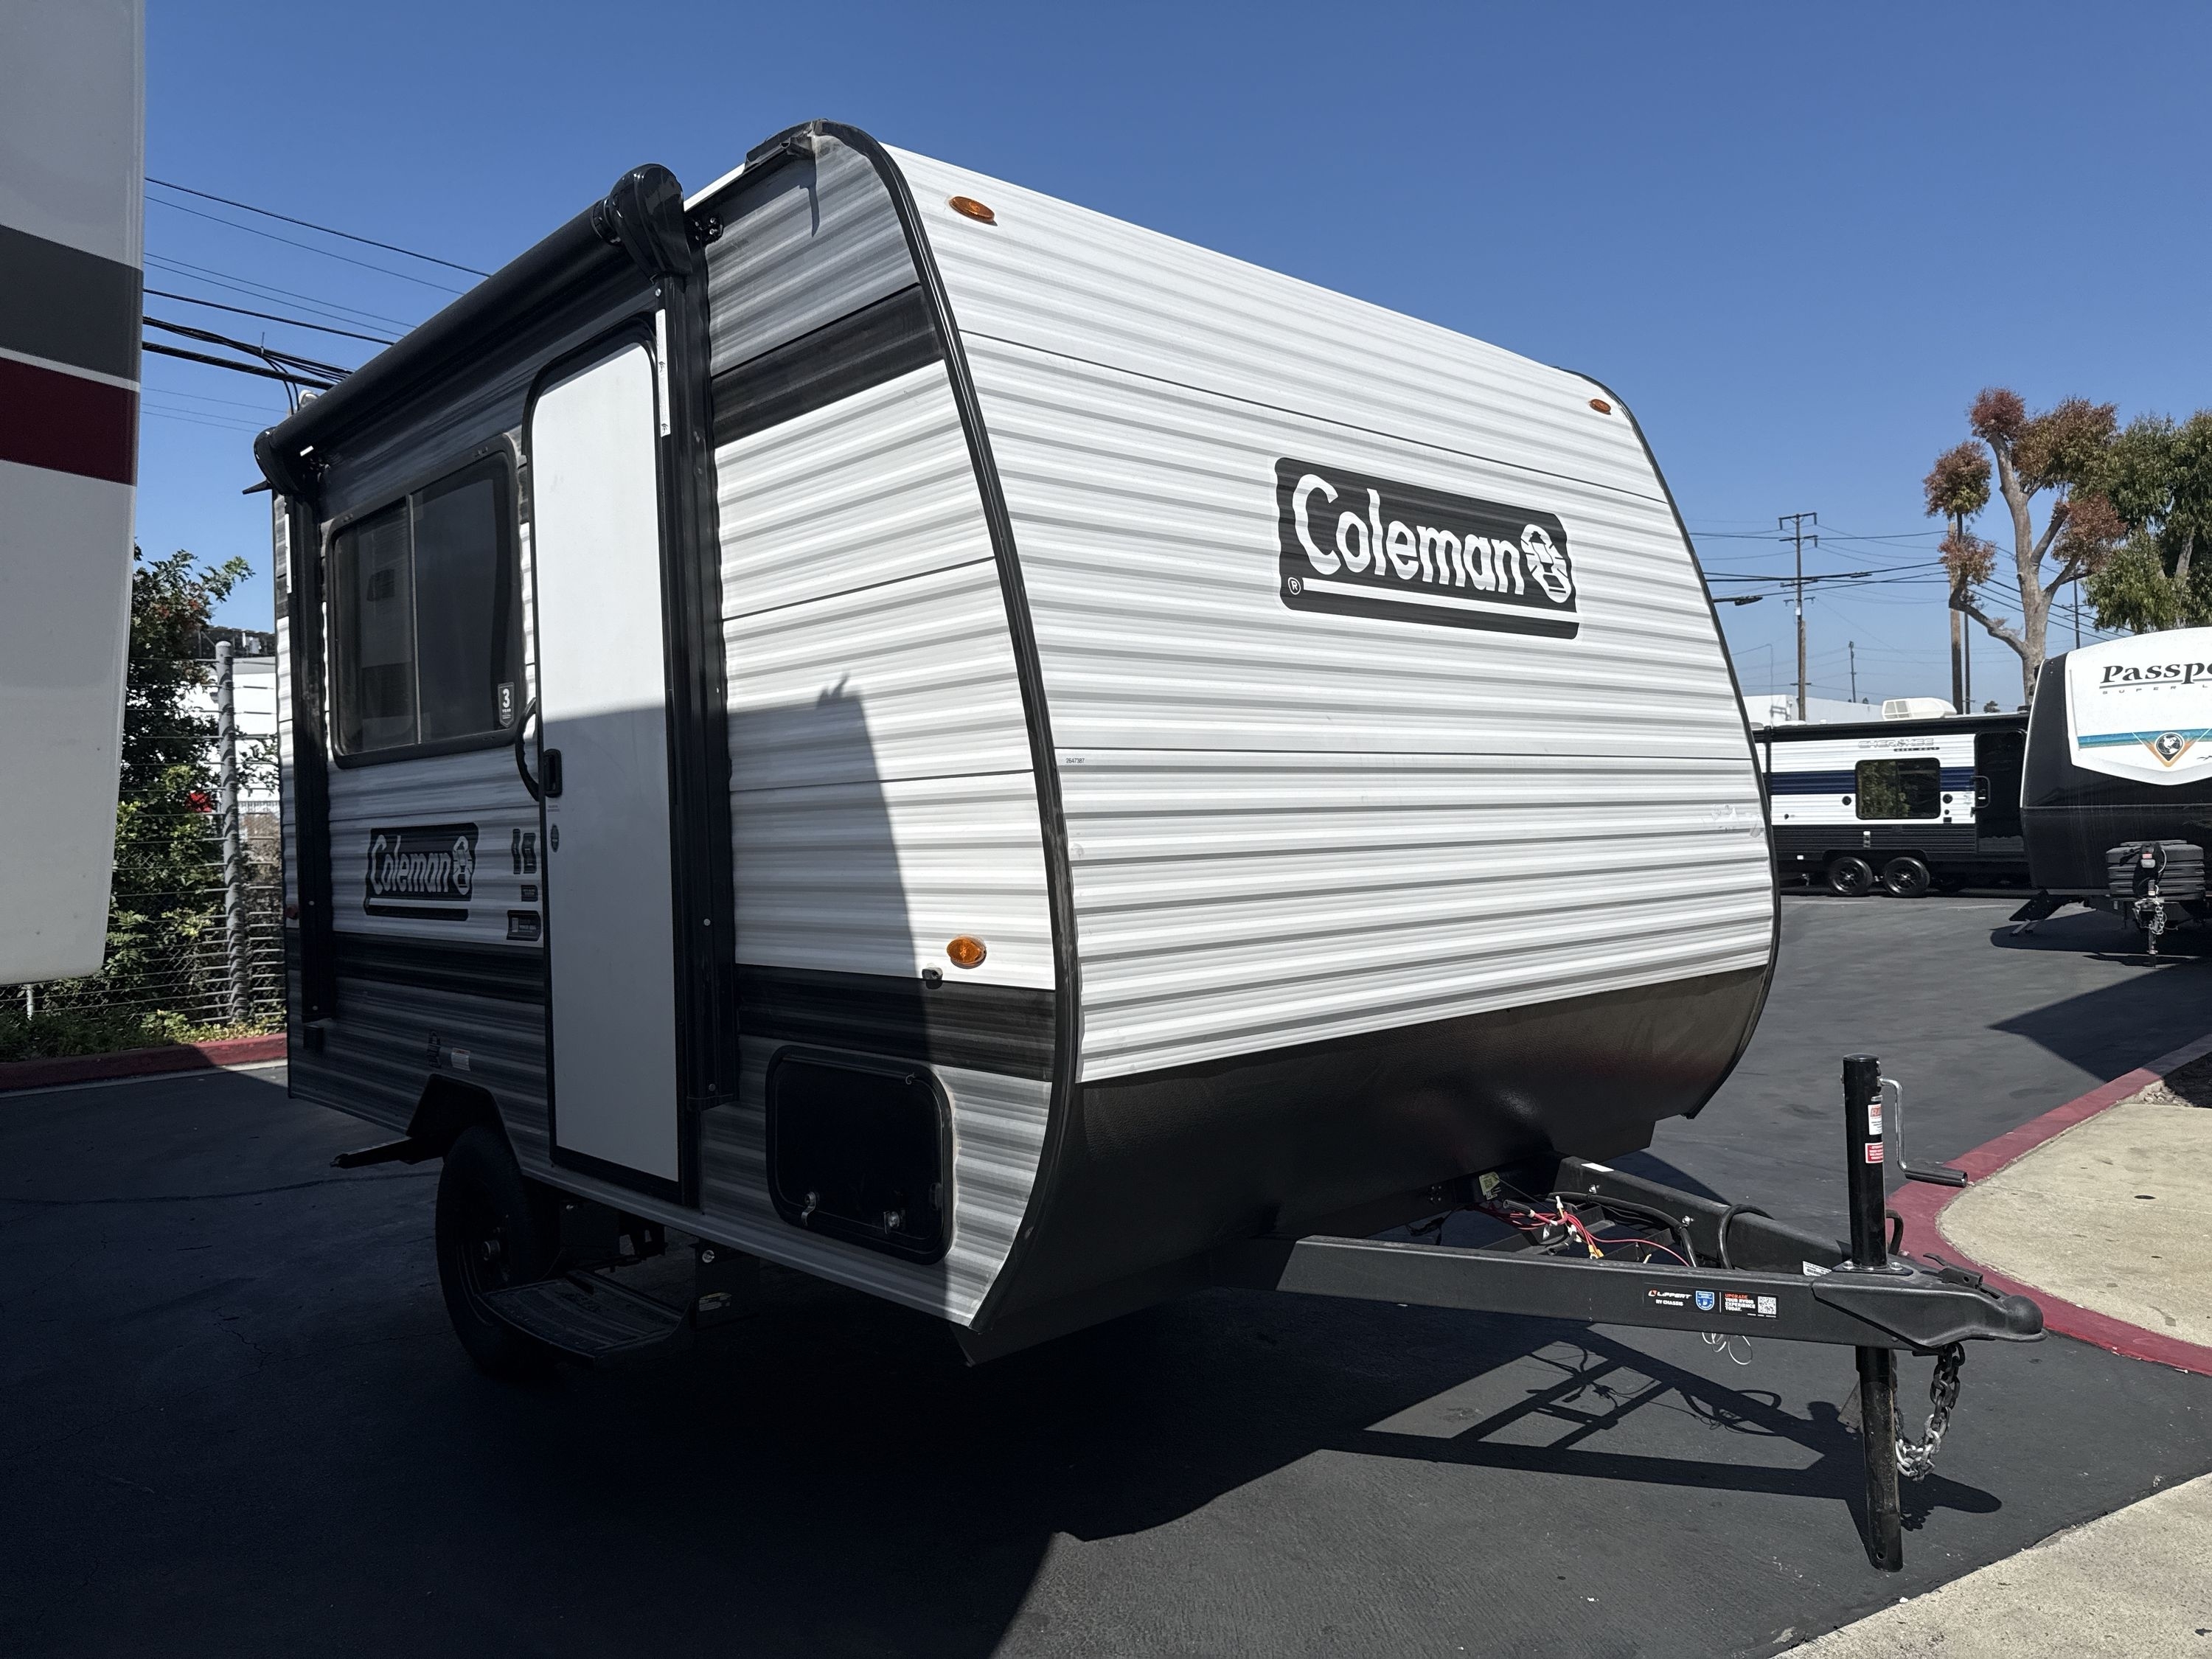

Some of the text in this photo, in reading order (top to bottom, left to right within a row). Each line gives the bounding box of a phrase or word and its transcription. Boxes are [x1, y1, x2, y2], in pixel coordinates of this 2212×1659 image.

[1292, 473, 1526, 596] Coleman
[502, 688, 510, 709] 3
[370, 834, 451, 895] Coleman
